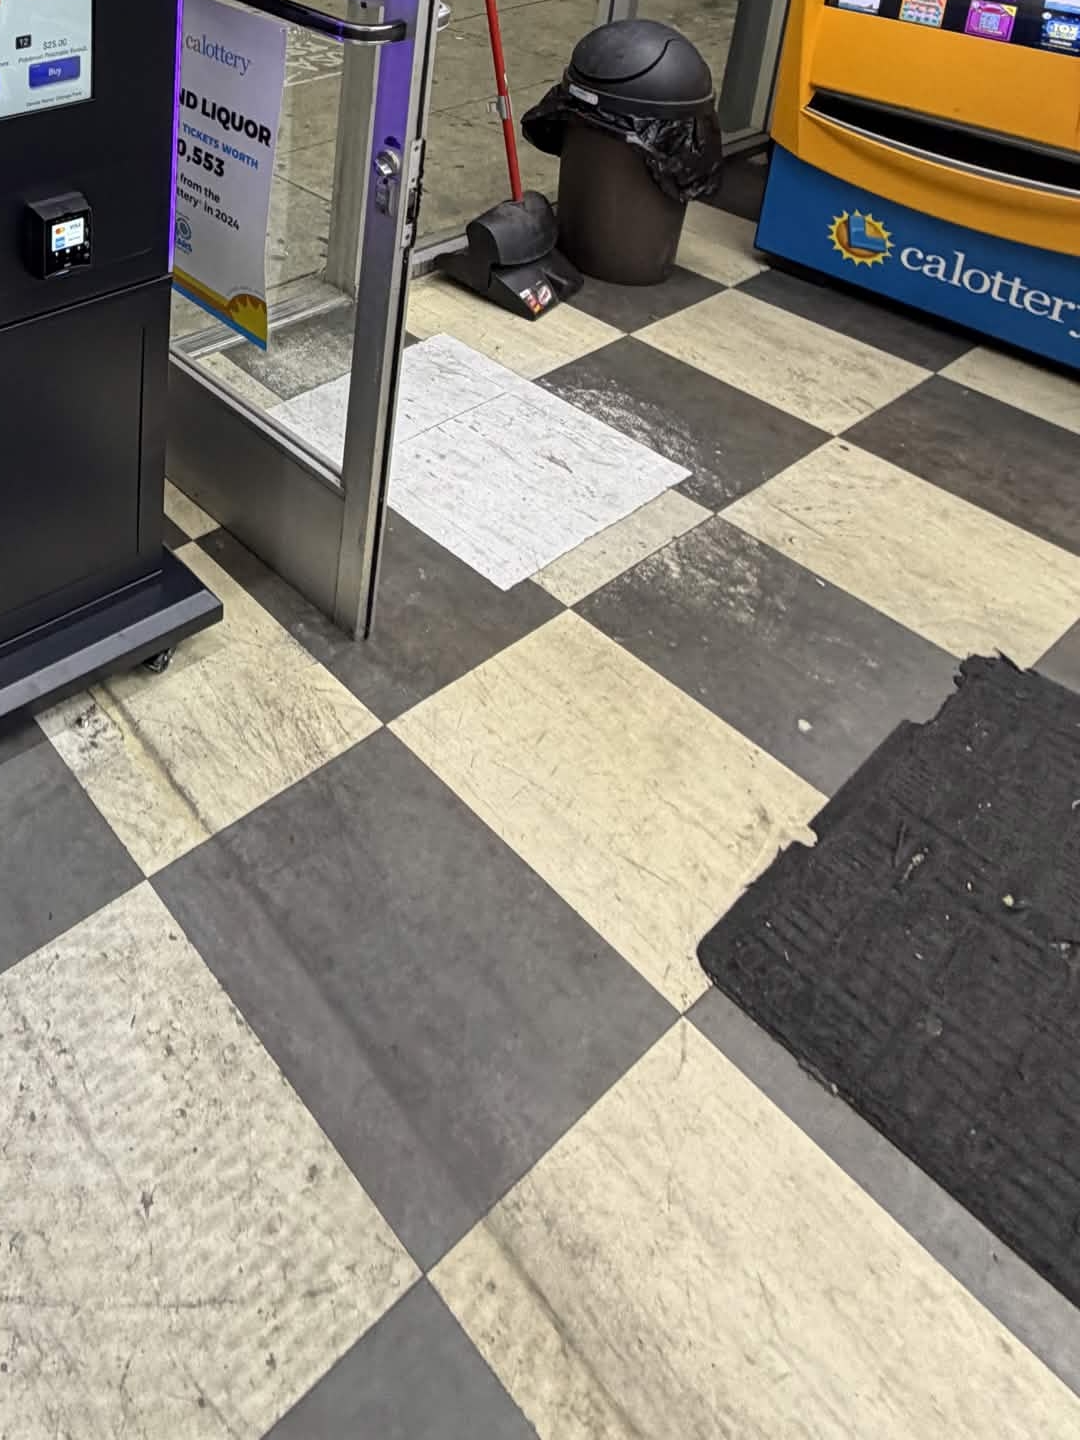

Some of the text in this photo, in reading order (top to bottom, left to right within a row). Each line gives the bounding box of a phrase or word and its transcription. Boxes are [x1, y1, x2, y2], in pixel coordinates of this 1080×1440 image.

[19, 37, 29, 47] 12
[185, 34, 252, 76] calottery
[48, 66, 62, 77] Buy
[200, 97, 271, 148] LIQUOR
[183, 122, 258, 170] TICKETS WORTH
[180, 172, 221, 203] from the
[204, 200, 214, 216] in
[216, 209, 240, 231] 2024
